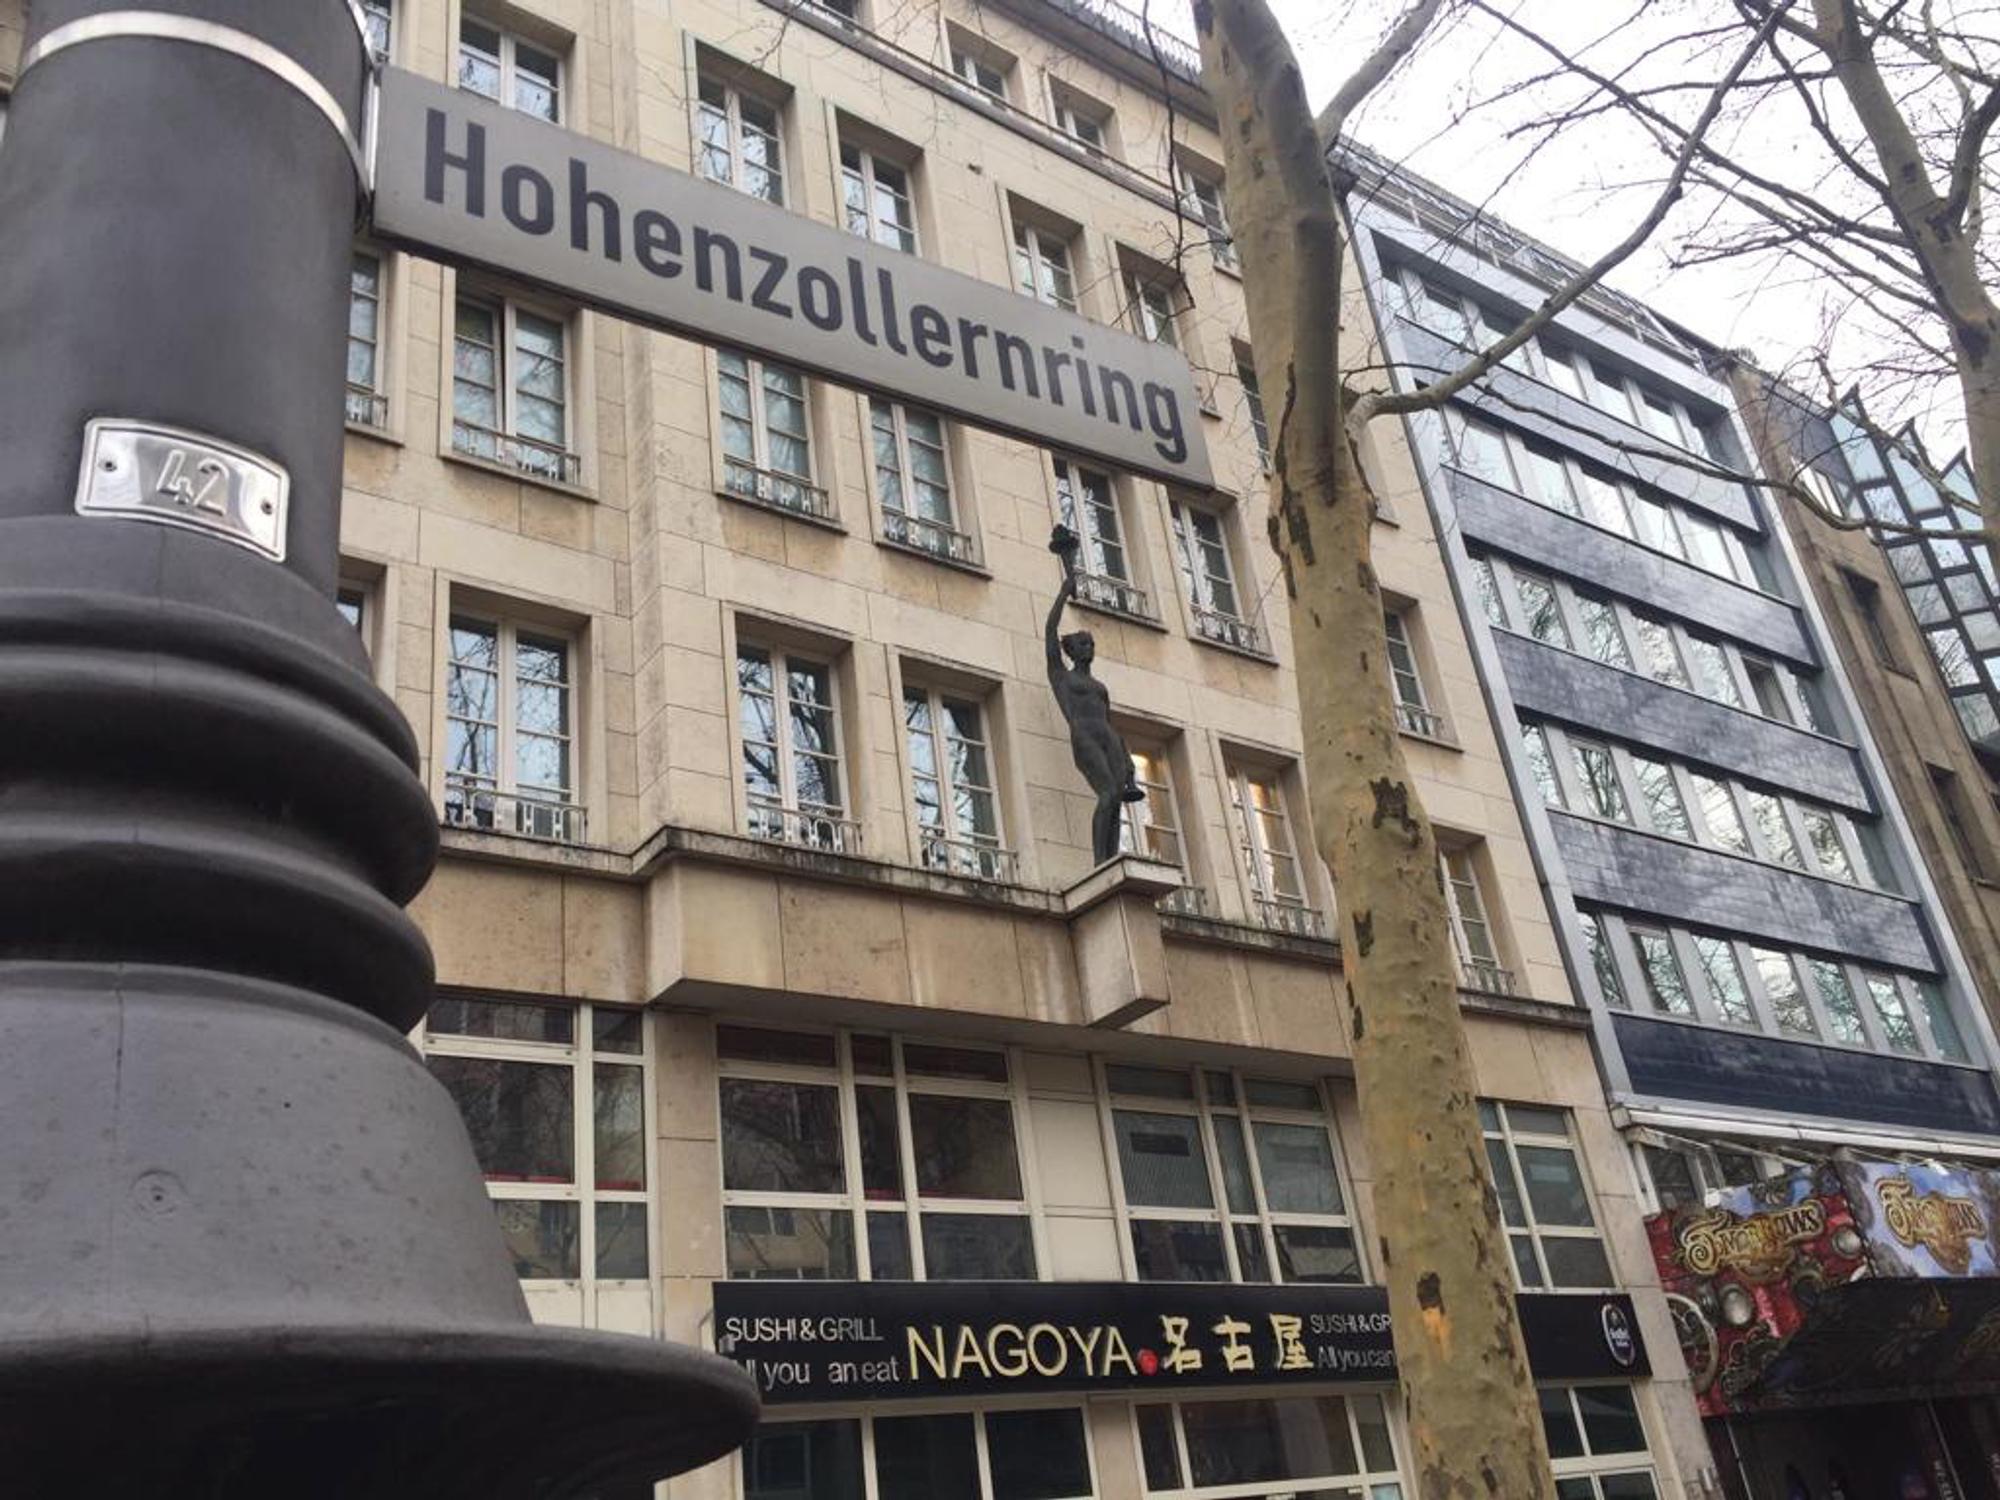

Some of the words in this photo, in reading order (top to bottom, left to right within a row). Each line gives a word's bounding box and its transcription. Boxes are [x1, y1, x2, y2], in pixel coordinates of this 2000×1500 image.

[424, 108, 1188, 465] Hohenzollernring
[156, 449, 229, 517] 42
[763, 1361, 811, 1391] you
[907, 1323, 1138, 1380] NAGOYA
[1160, 1314, 1314, 1374] 名古屋
